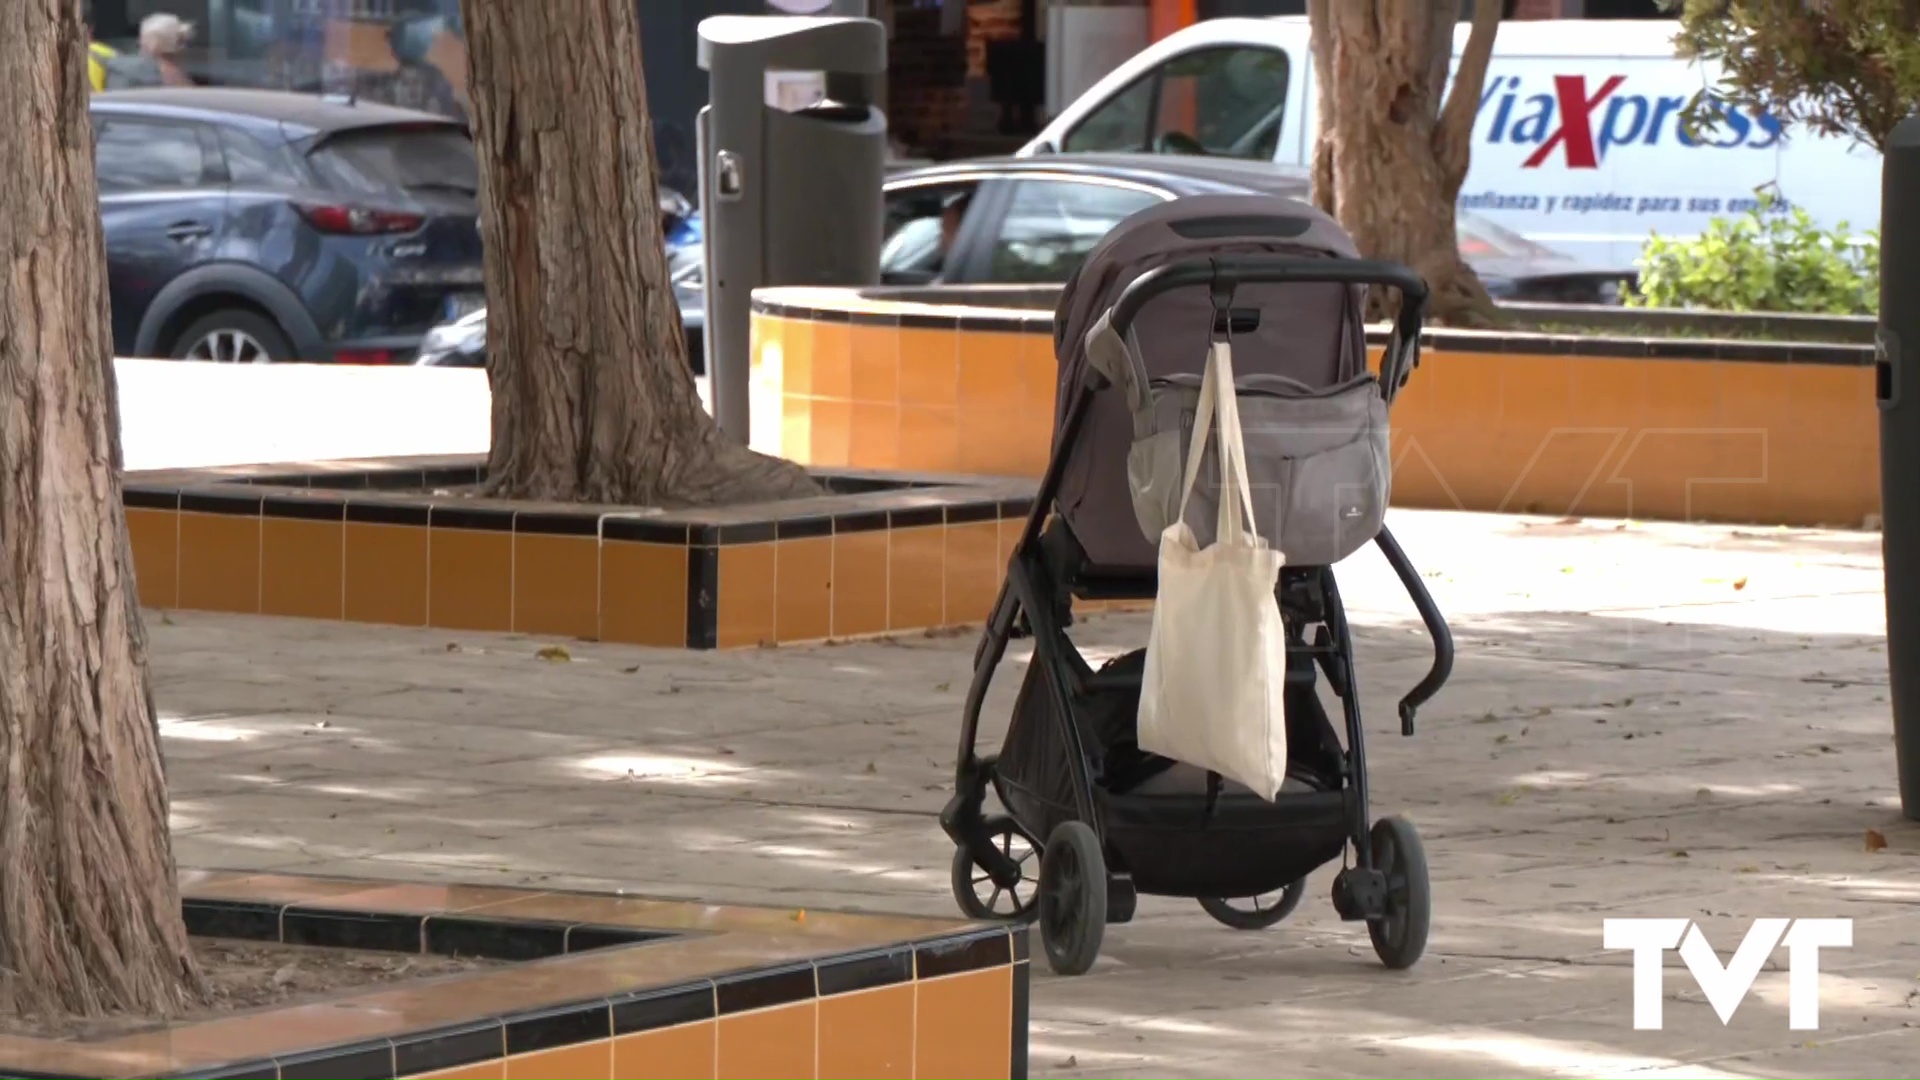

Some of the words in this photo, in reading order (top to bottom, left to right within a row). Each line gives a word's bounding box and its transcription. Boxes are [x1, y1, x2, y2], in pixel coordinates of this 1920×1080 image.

[1458, 190, 1539, 209] onfianza
[1544, 195, 1559, 214] y
[1562, 191, 1632, 214] rapidez
[1636, 196, 1682, 215] para
[1688, 197, 1720, 213] sus
